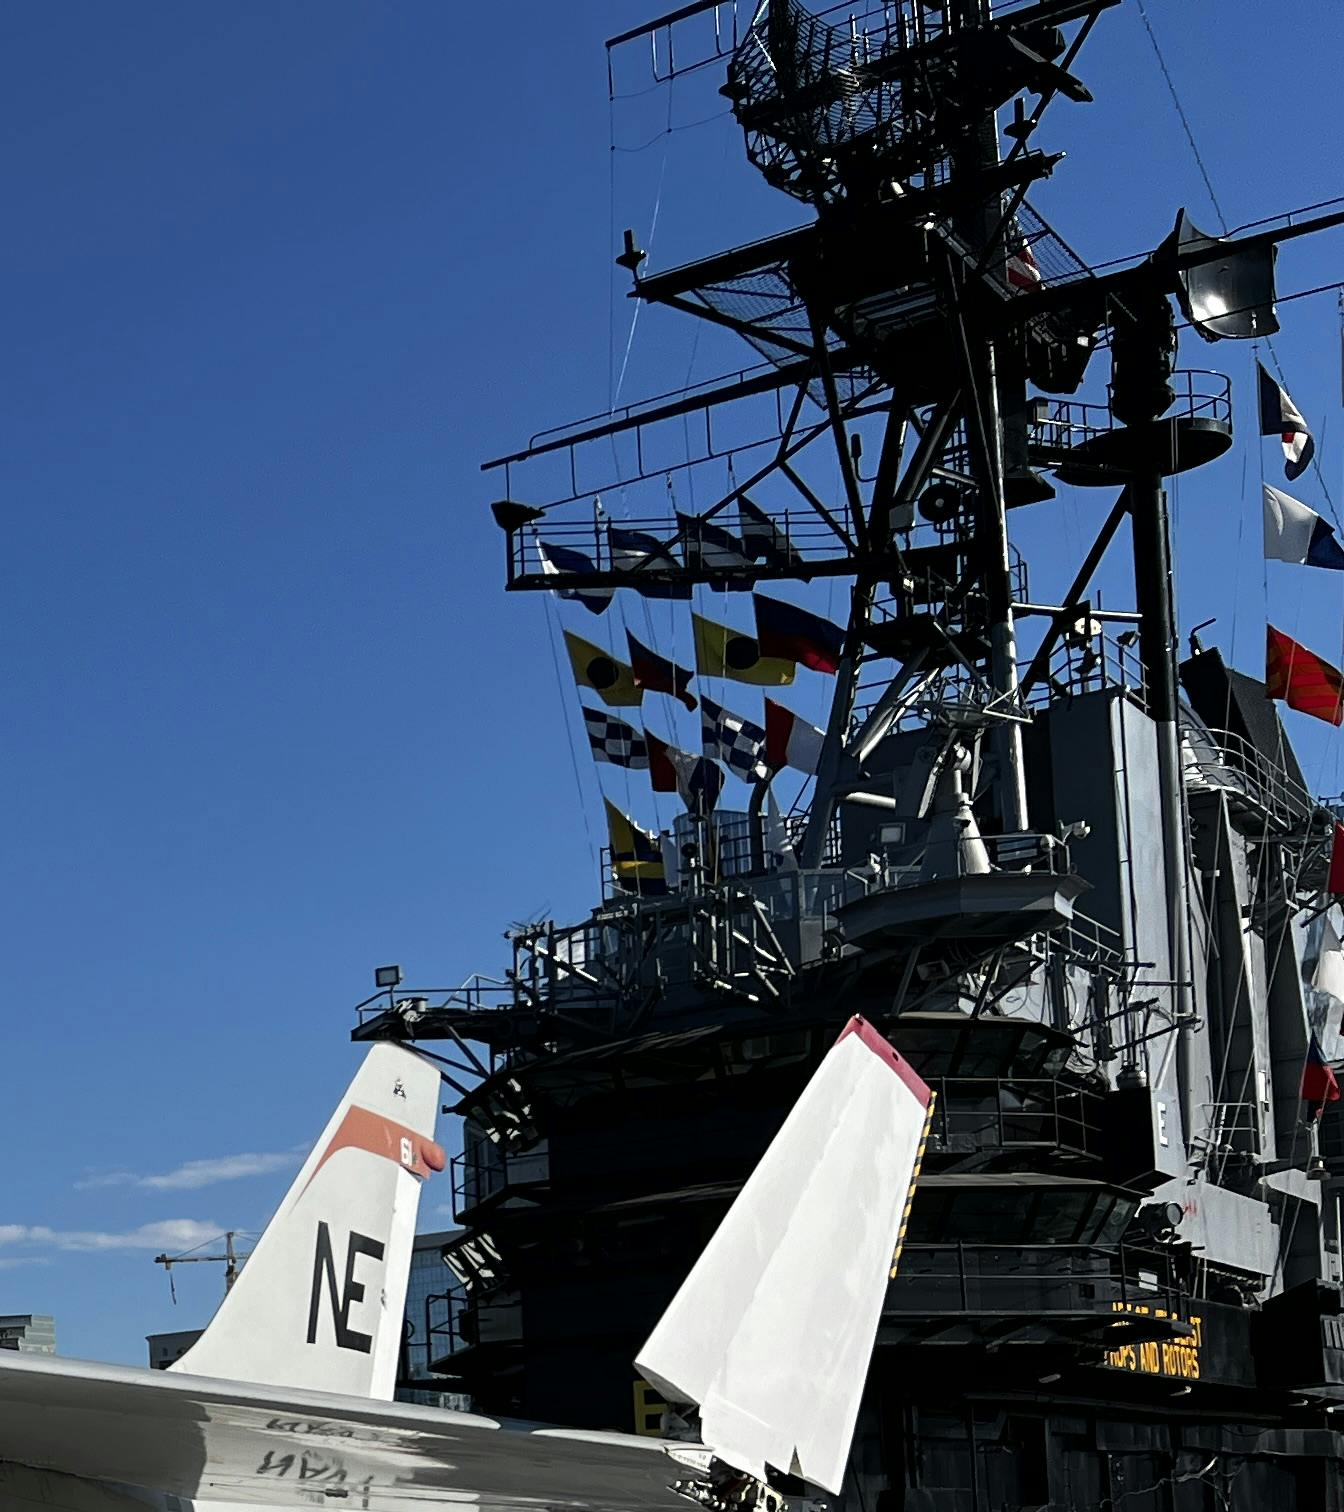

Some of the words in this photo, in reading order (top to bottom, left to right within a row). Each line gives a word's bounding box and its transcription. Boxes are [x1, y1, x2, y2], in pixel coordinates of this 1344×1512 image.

[307, 1220, 385, 1354] NE
[1140, 1341, 1160, 1374] AND
[1162, 1343, 1200, 1379] ROTORS
